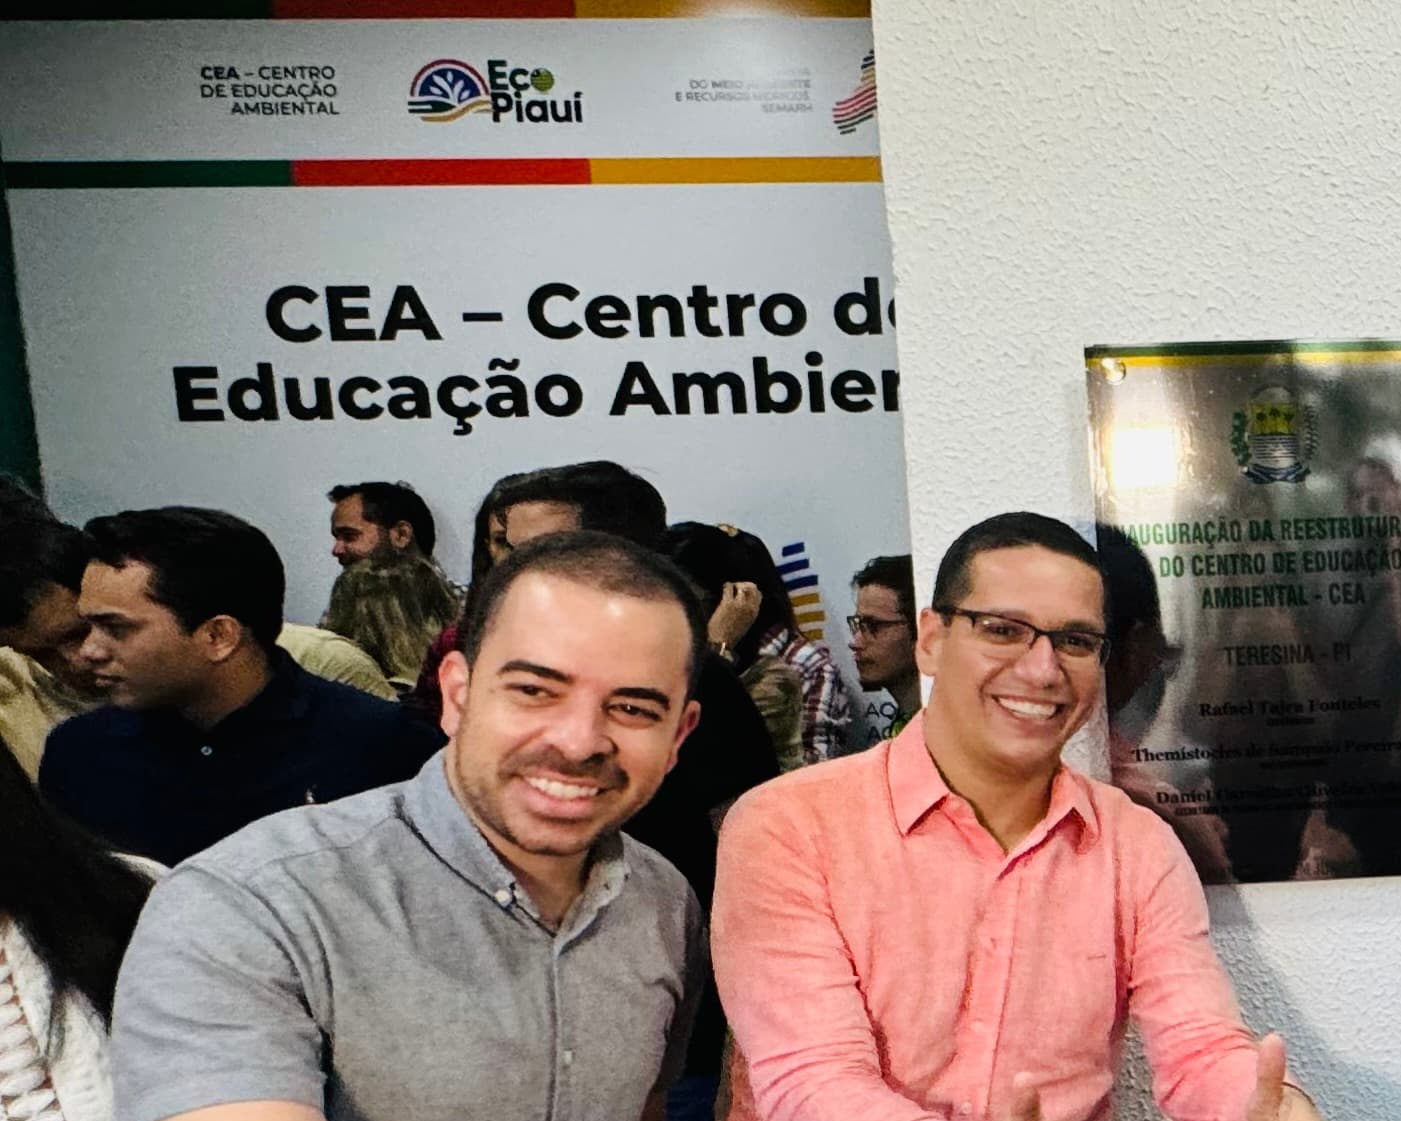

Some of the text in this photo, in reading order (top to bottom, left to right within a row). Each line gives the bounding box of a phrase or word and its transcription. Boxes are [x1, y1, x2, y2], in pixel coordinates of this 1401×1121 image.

[201, 66, 239, 81] CEA
[258, 65, 335, 80] CENTRO
[487, 60, 555, 93] Eco
[201, 81, 337, 101] DE EDUCAÇÃO
[231, 102, 341, 116] AMBIENTAL
[491, 91, 583, 123] Piauí
[266, 285, 444, 343] CEA
[528, 282, 807, 340] Centro
[834, 277, 897, 336] d
[173, 358, 583, 436] Educação
[1249, 519, 1275, 542] DA
[1159, 556, 1185, 577] DO
[1191, 553, 1265, 577] CENTRO
[1272, 552, 1297, 573] DE
[1202, 583, 1308, 609] AMBIENTAL
[1328, 582, 1366, 605] CEA
[1224, 643, 1314, 666] TERESINA
[1333, 641, 1350, 662] PI
